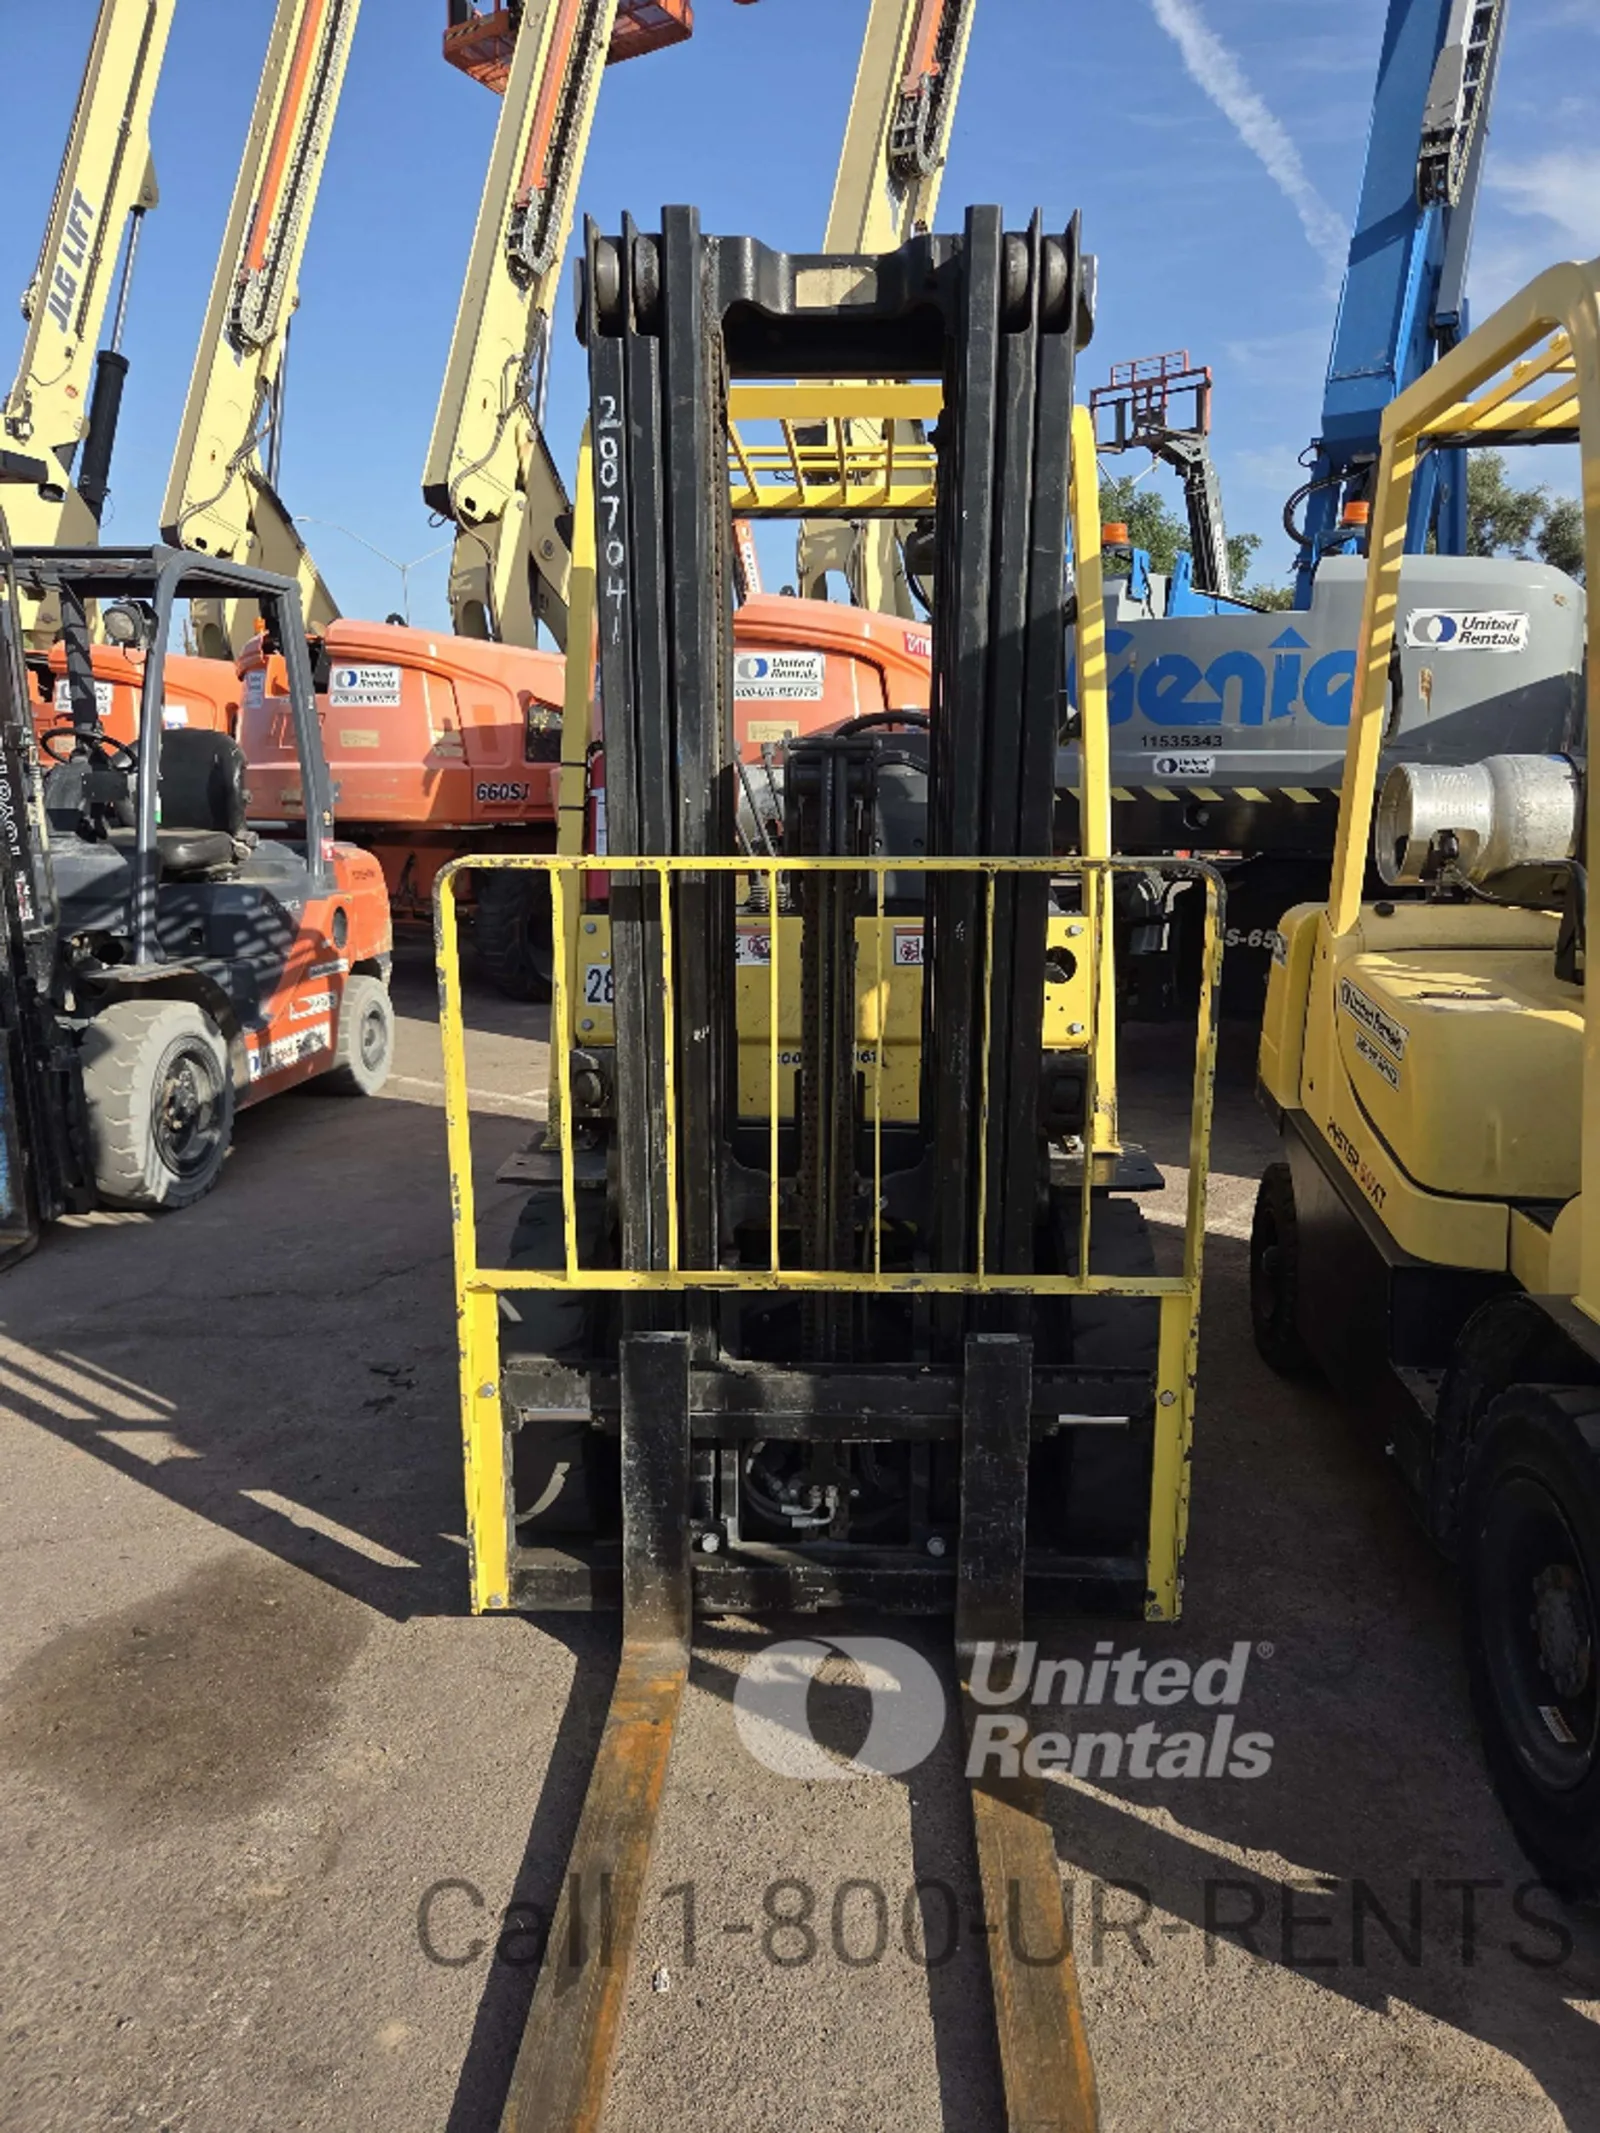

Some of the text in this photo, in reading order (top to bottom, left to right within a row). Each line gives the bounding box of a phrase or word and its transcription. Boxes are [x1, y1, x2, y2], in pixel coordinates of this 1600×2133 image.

[48, 187, 94, 334] JLG LIFT
[1461, 616, 1520, 632] United
[1458, 631, 1521, 646] Rentals
[771, 657, 817, 668] United
[770, 668, 818, 680] Rentals
[1141, 734, 1223, 748] 11535343
[476, 783, 531, 801] 660SJ
